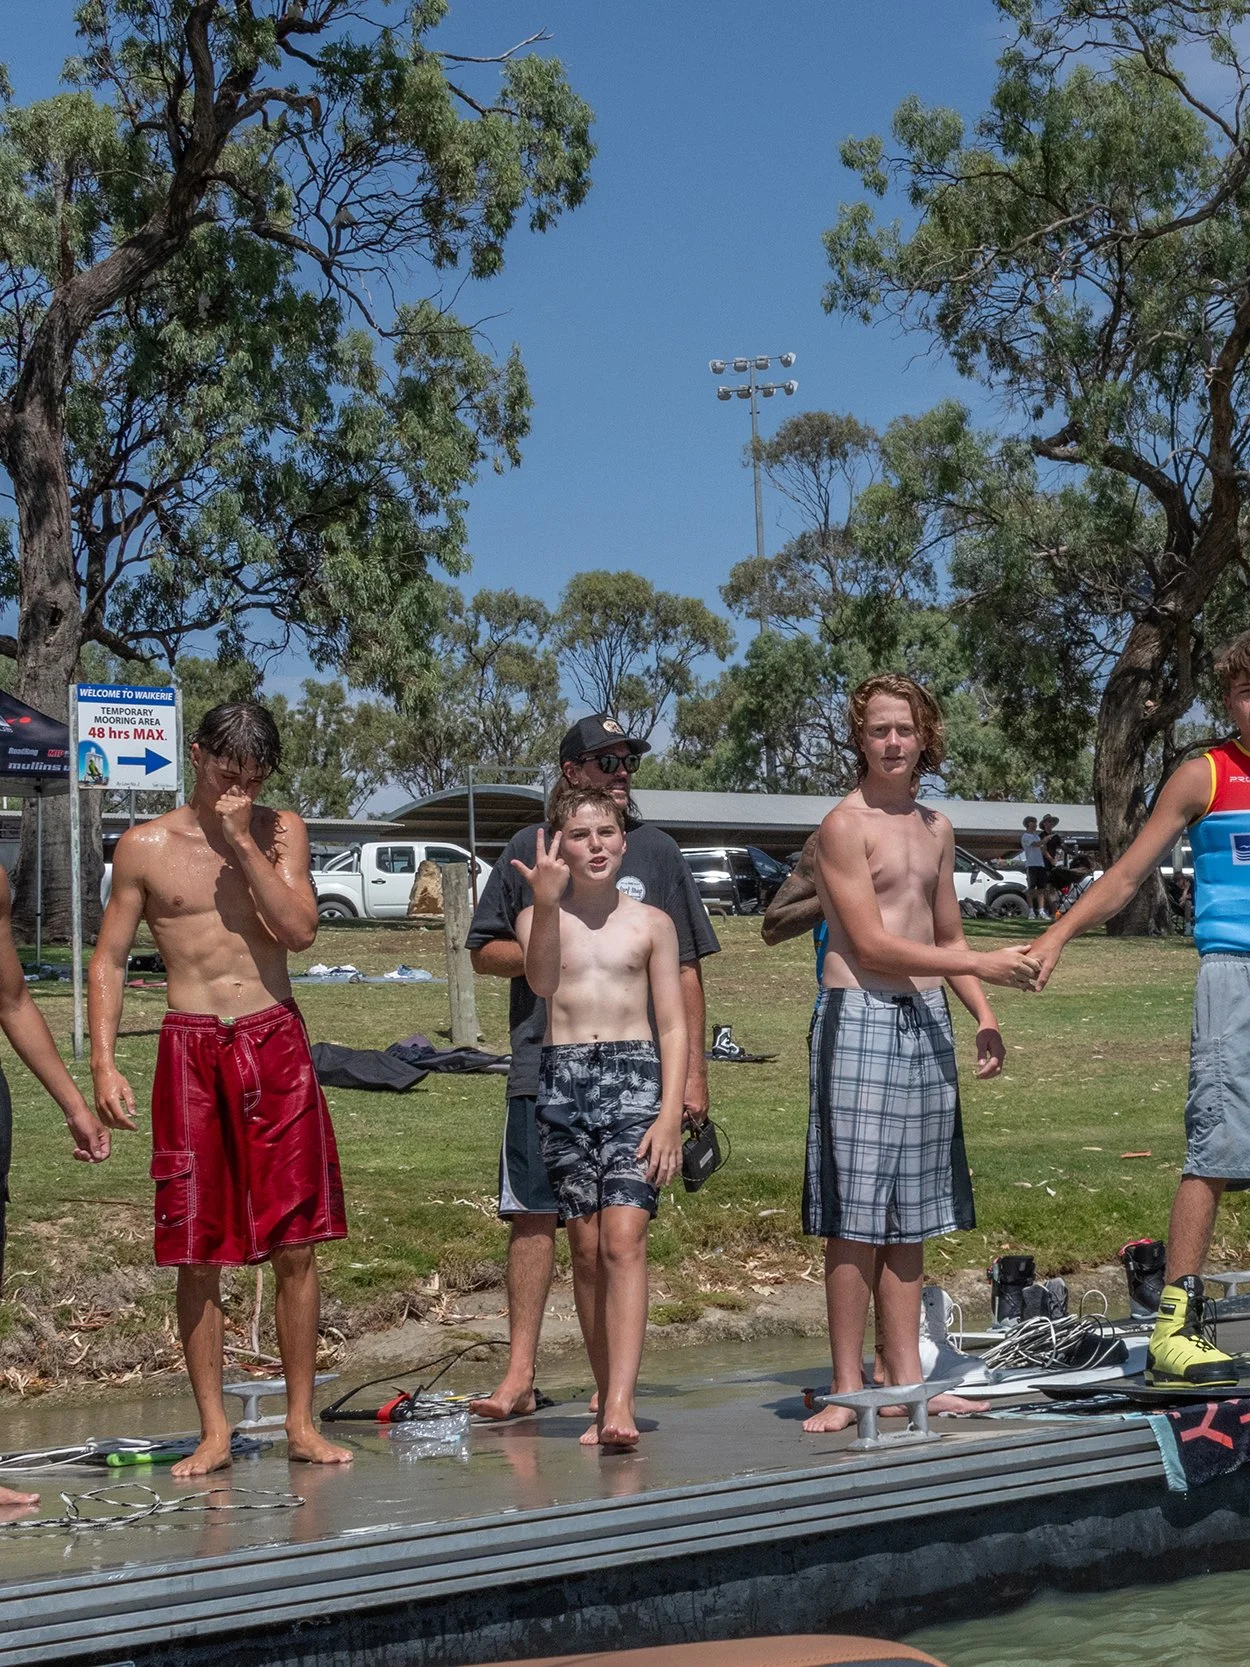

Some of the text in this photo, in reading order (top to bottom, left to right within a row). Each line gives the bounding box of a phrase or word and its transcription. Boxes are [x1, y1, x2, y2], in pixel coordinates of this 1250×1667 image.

[79, 688, 173, 701] WELCOME TO WAIKERIE
[100, 706, 154, 716] TEMPORARY
[94, 715, 161, 726] MOORING AREA
[88, 727, 168, 741] 48 hrs MAX.
[8, 761, 62, 771] mullins
